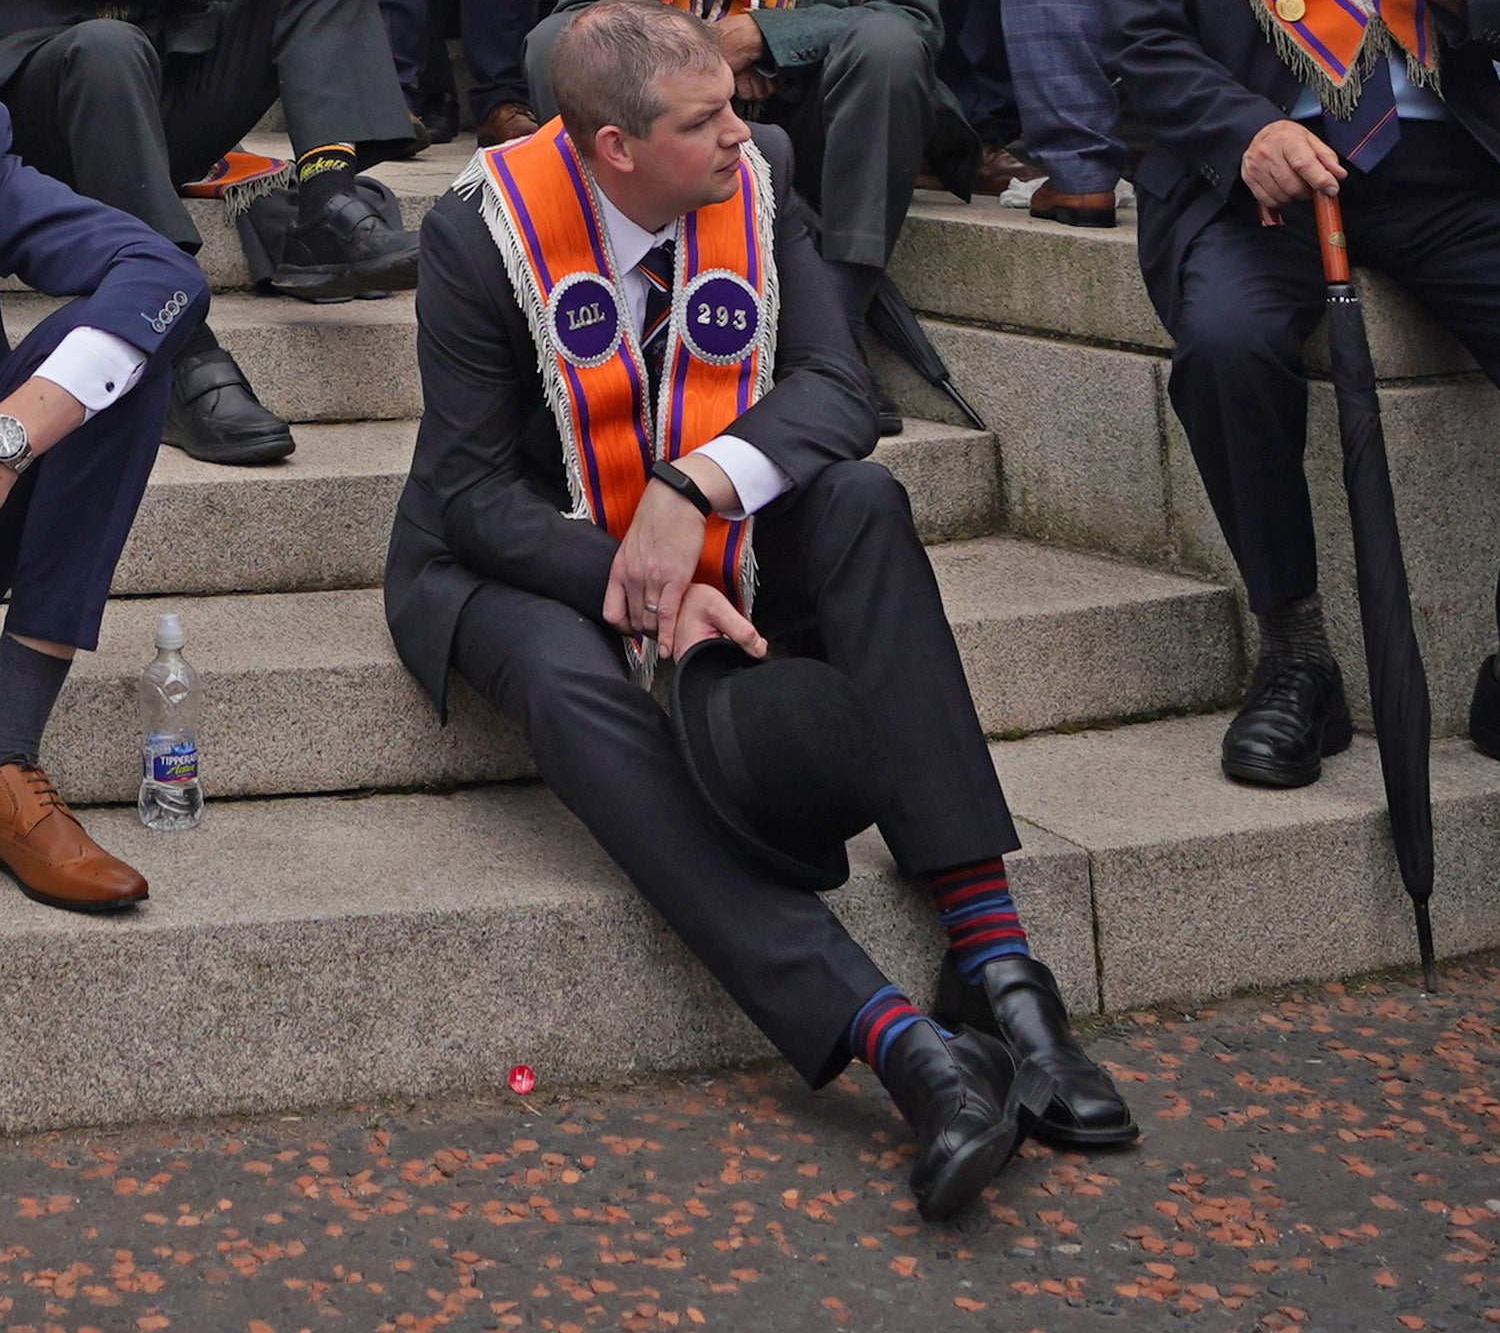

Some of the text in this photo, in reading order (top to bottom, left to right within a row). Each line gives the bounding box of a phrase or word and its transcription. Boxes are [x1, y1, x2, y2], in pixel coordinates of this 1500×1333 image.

[566, 301, 607, 331] LOL
[697, 302, 748, 331] 293
[160, 753, 197, 766] TIPPERA
